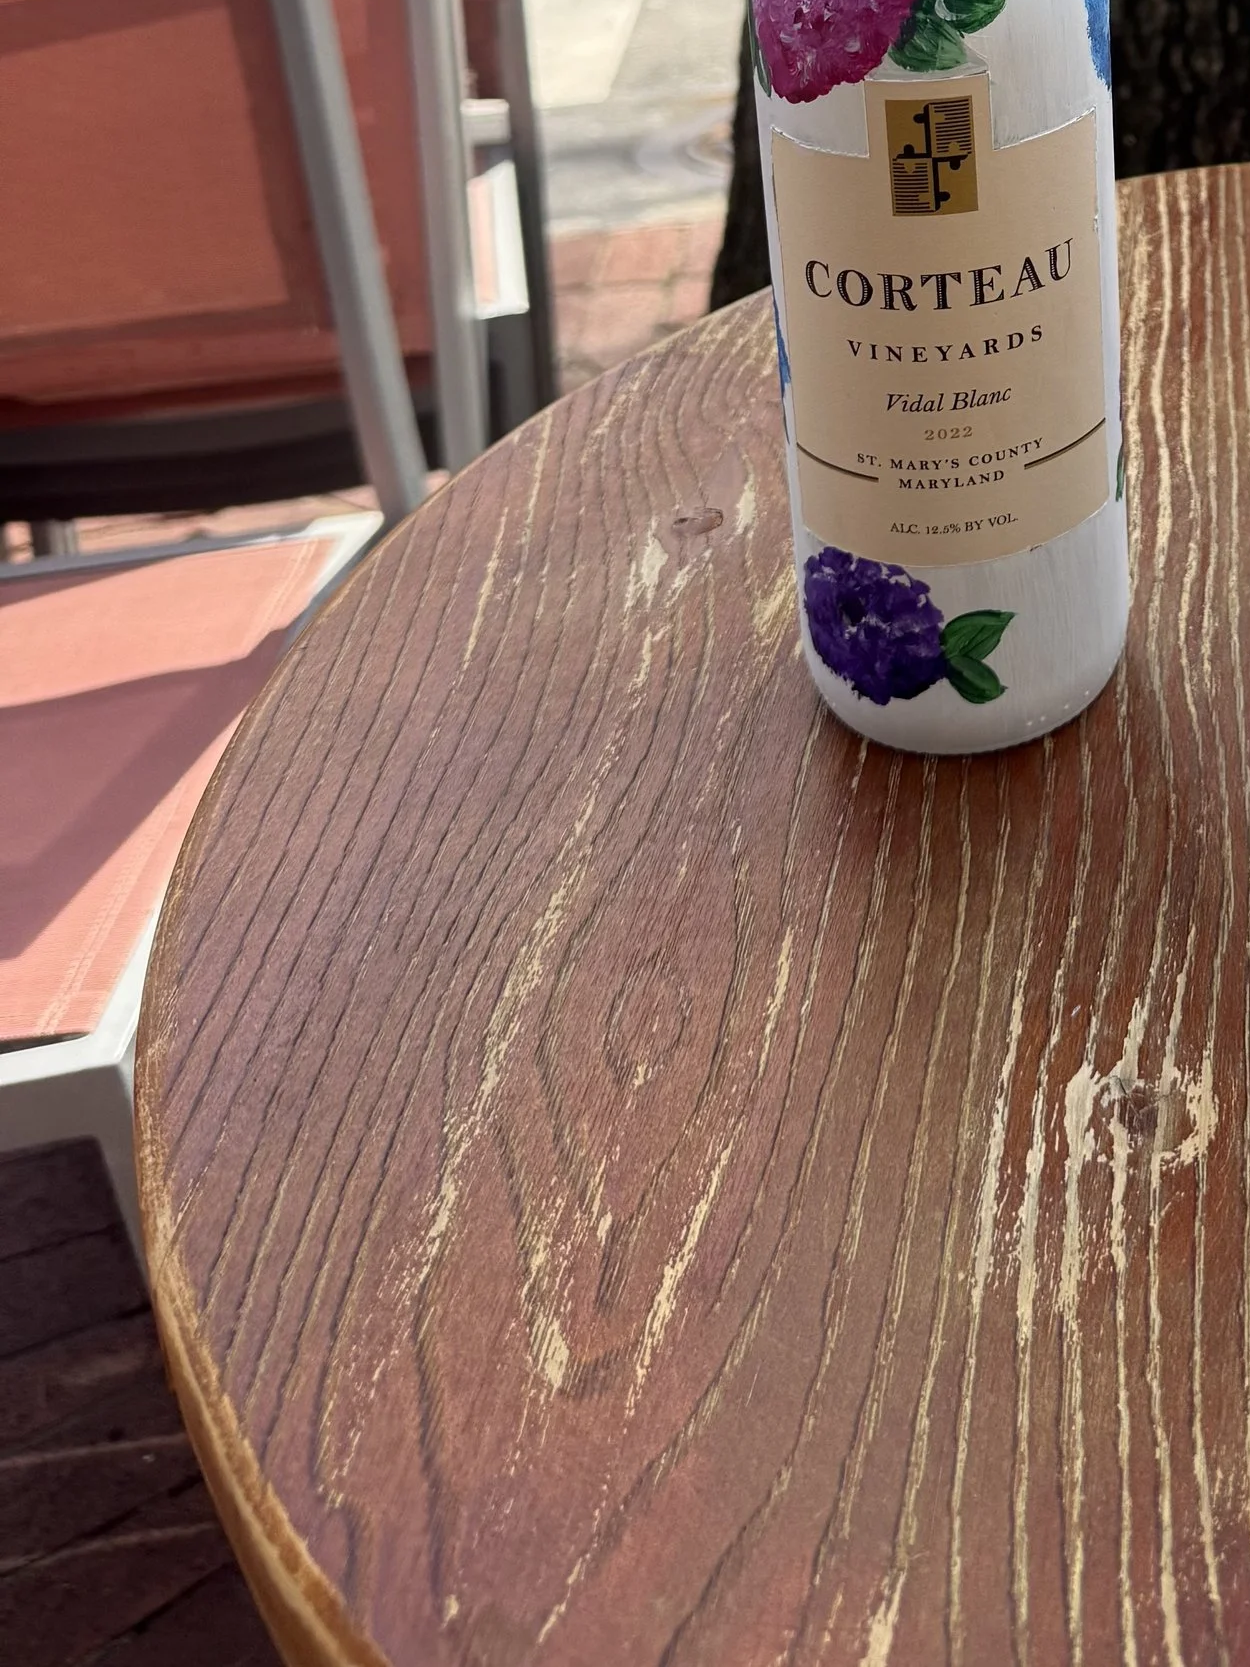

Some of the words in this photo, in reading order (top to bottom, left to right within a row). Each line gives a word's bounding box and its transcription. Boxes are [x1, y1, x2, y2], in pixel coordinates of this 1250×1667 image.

[805, 237, 1074, 312] CORTEAU
[846, 324, 1043, 363] VINEYARDS
[886, 391, 945, 413] Vidal
[949, 387, 1012, 412] Blanc
[924, 425, 974, 441] 2022
[857, 452, 883, 468] ST.
[889, 457, 960, 471] MARY'S
[968, 437, 1044, 467] COUNTY
[898, 470, 1005, 490] MARYLAND
[890, 522, 921, 535] ALC.
[926, 522, 962, 535] 12.5%
[964, 519, 984, 533] BY
[987, 513, 1019, 528] VOL.
